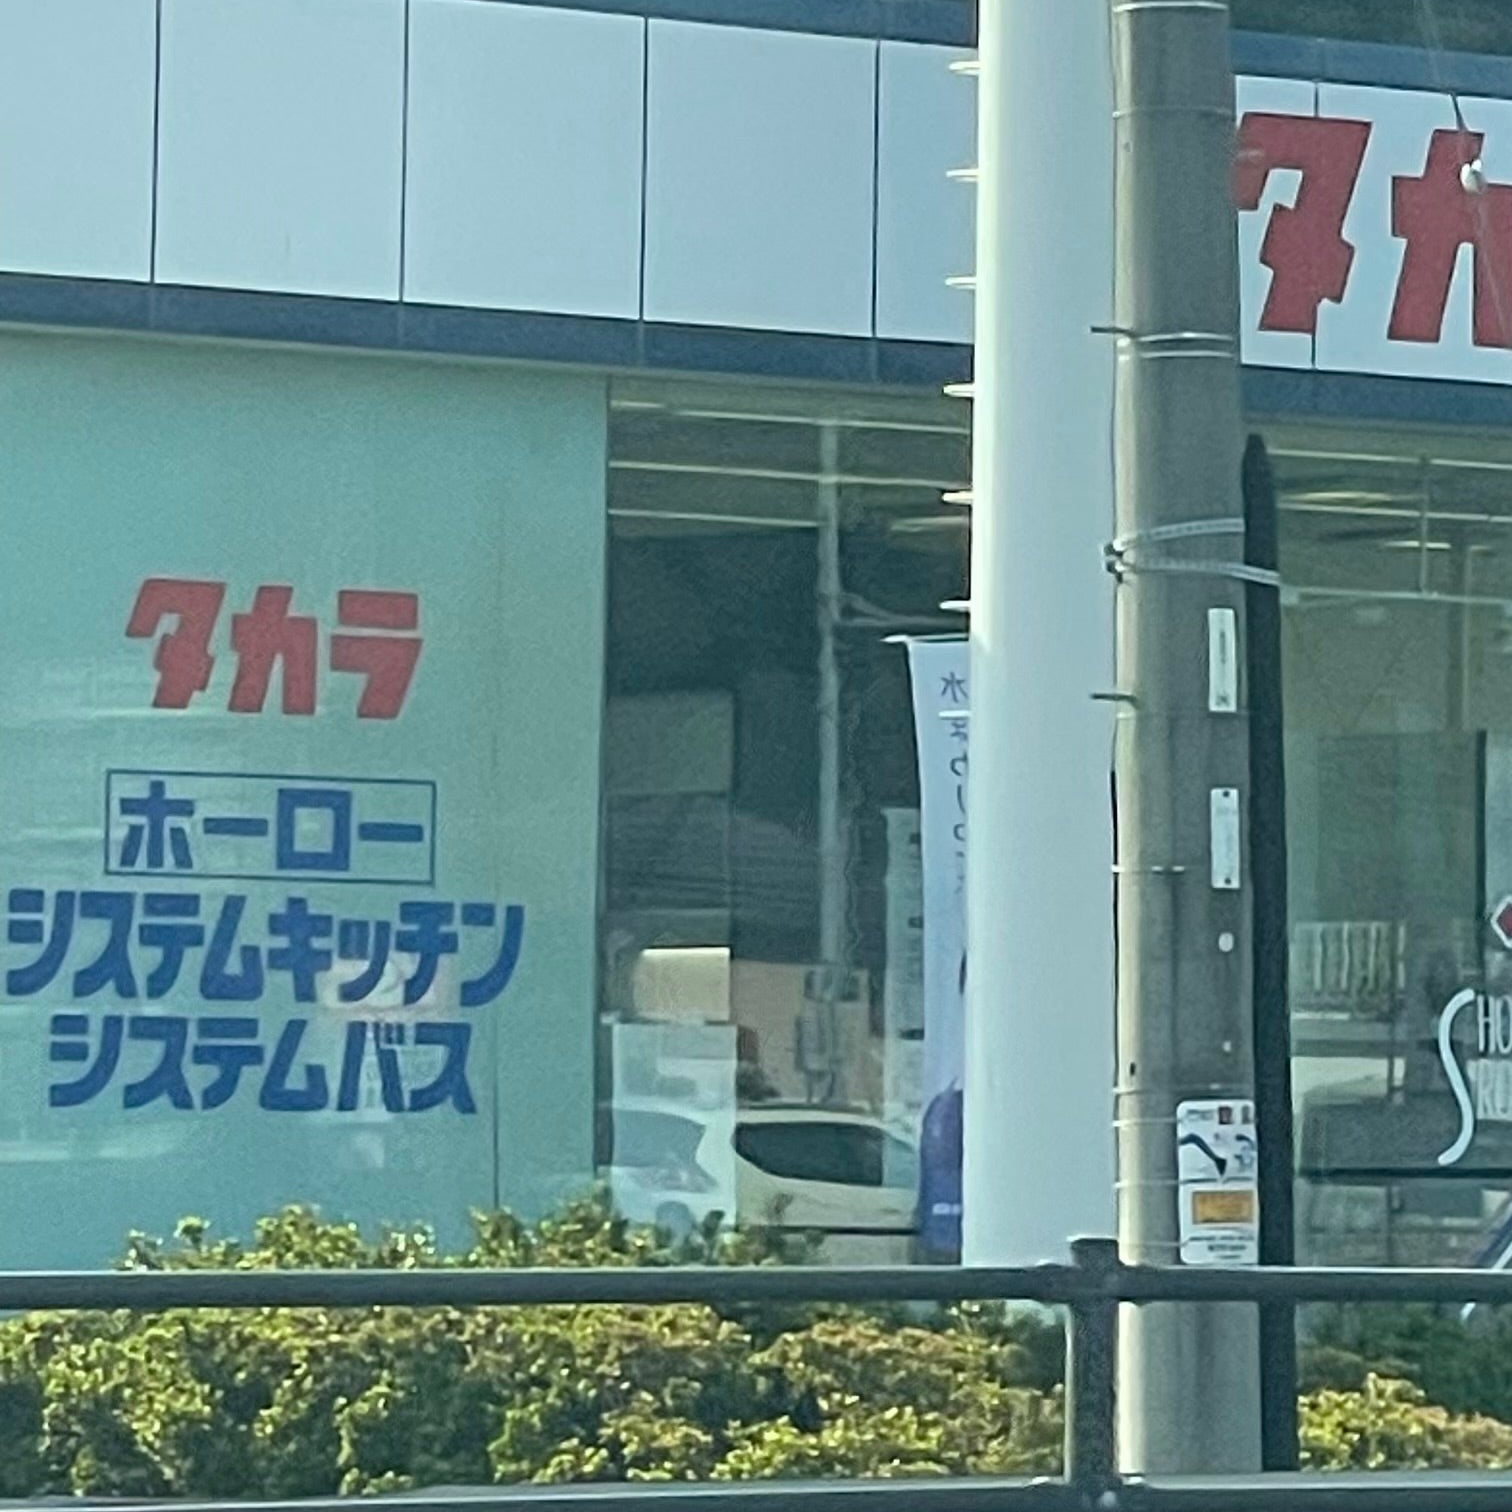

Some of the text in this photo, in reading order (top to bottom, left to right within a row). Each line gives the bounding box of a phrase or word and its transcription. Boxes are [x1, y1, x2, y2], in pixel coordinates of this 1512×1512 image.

[125, 577, 424, 720] タカラ
[118, 780, 425, 872] ホーロー
[3, 889, 526, 1009] システムキッチン
[49, 1013, 477, 1115] システムバス
